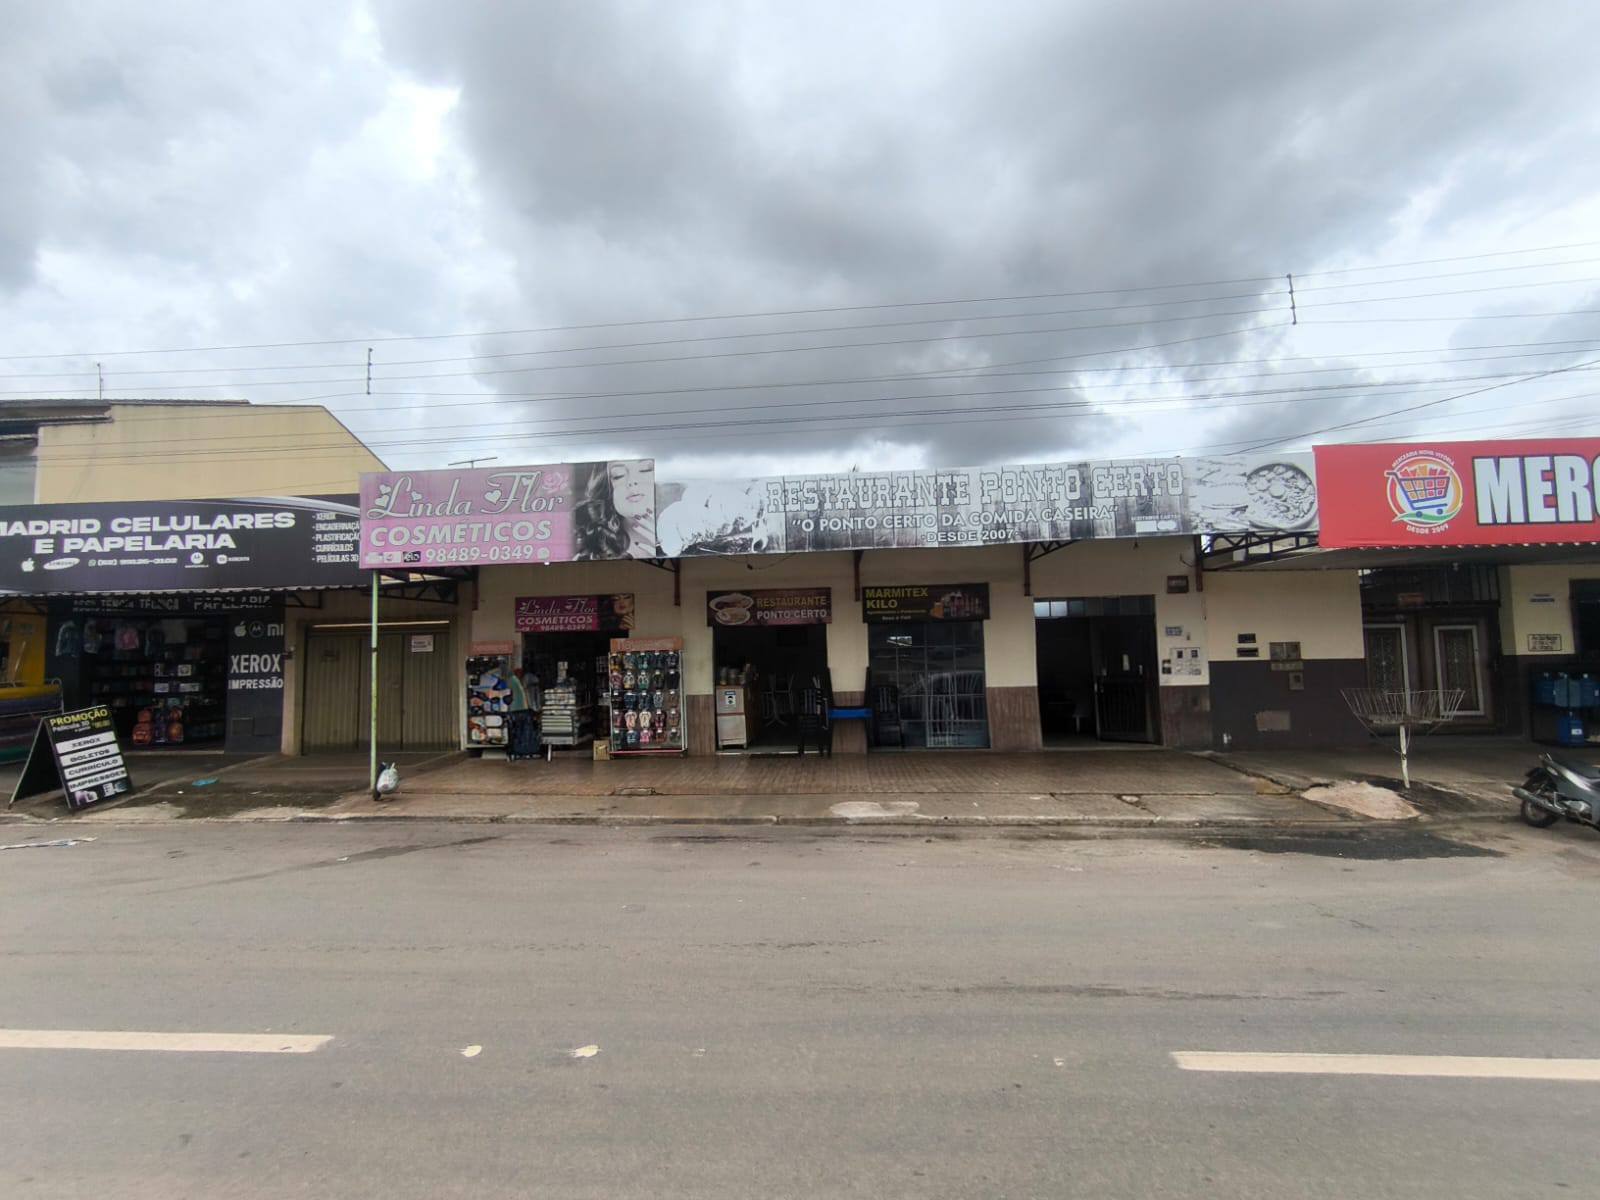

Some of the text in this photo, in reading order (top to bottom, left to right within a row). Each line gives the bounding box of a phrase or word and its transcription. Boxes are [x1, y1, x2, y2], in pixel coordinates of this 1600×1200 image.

[367, 471, 563, 519] Linda Flor
[767, 463, 1184, 513] RESTAURANTE PONTO CERTO
[1472, 455, 1600, 525] MER
[110, 512, 296, 533] CELULARES
[819, 516, 878, 532] PONTO
[883, 514, 937, 529] CERTO
[942, 512, 965, 527] DA
[969, 511, 1038, 526] COMIDA
[370, 519, 551, 547] COSMÉTICOS
[926, 531, 977, 543] DESDE
[34, 533, 237, 554] E PAPELARIA
[426, 545, 534, 563] 98489-0349
[756, 596, 827, 608] RESTAURANTE
[865, 587, 928, 599] MARMITEX
[757, 609, 827, 620] PONTO CERTO
[866, 600, 898, 609] KILO
[230, 653, 281, 674] XEROX
[228, 676, 284, 689] IMPRESSÃO
[50, 708, 108, 727] PROMOÇÃO
